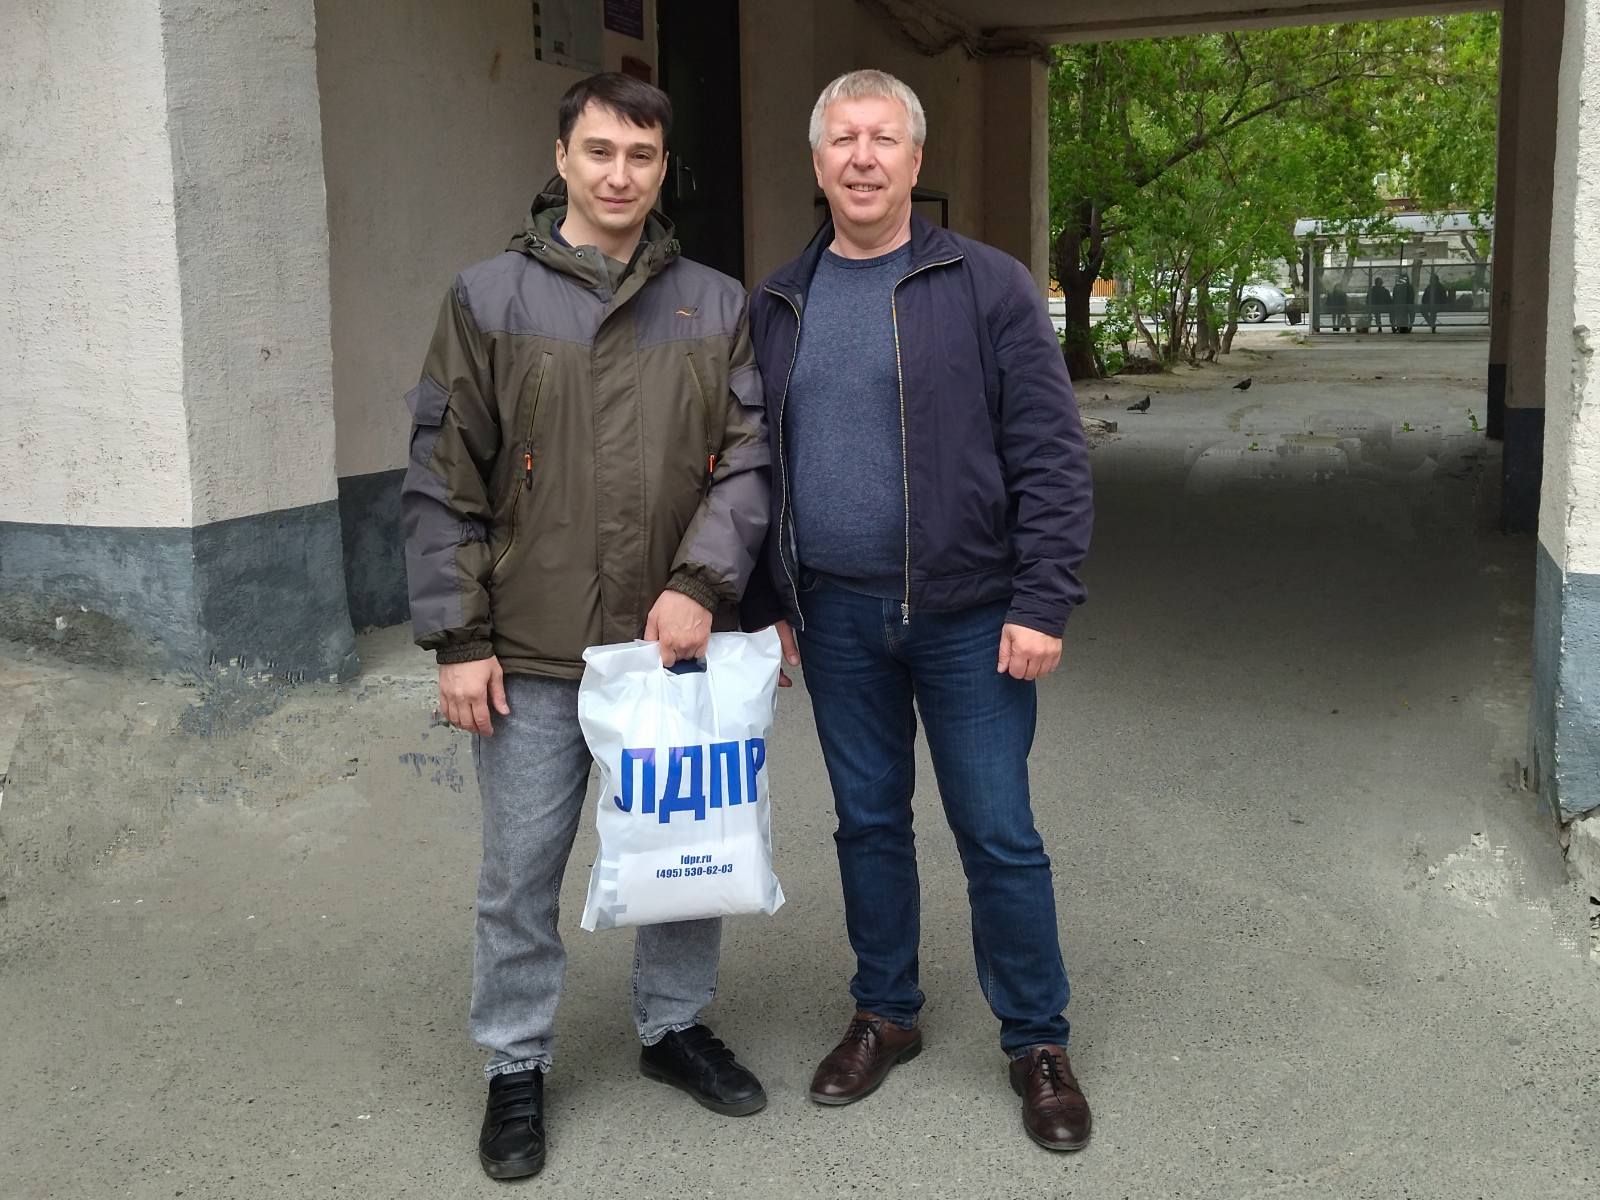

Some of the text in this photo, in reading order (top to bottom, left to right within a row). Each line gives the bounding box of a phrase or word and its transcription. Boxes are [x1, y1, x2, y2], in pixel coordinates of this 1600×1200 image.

[613, 737, 766, 824] ЛДПР
[680, 855, 712, 865] ldpr.ru
[656, 863, 733, 878] (495) 530-62-03
